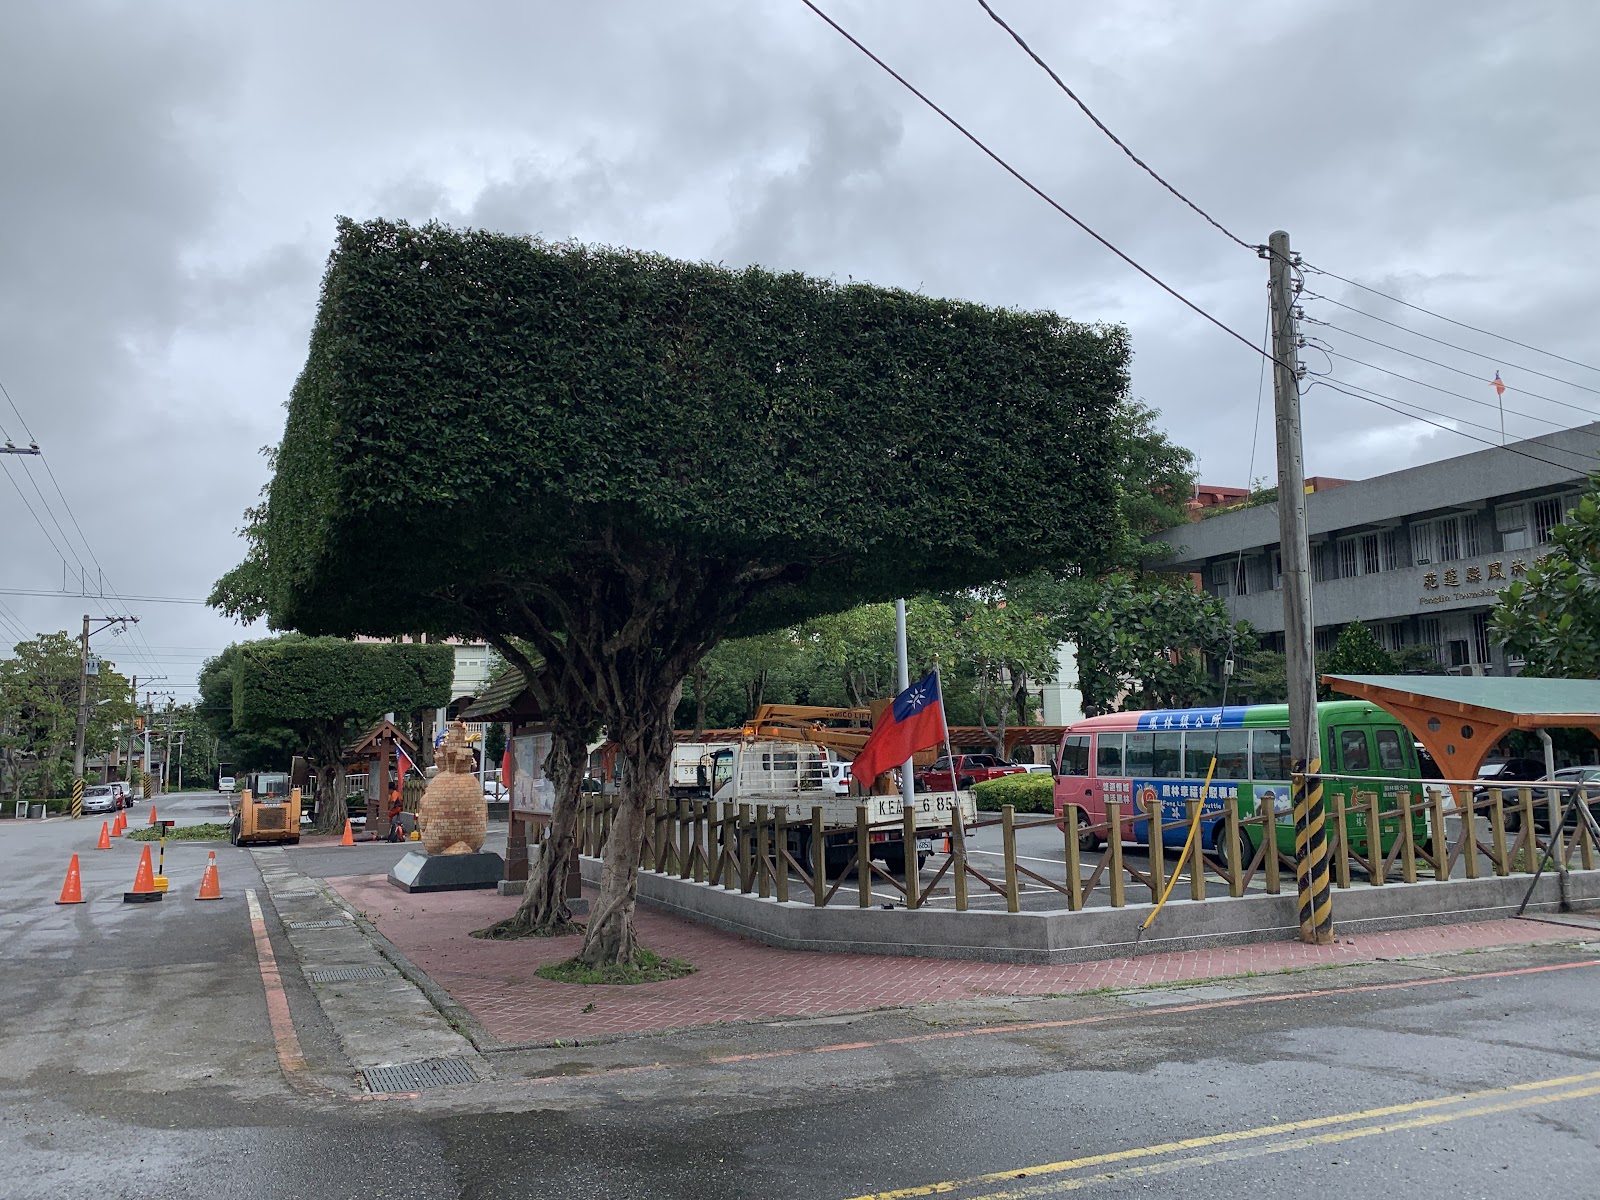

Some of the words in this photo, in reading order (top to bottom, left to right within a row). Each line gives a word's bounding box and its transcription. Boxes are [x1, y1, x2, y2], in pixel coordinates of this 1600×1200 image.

[1148, 713, 1222, 730] 鳳林鎮公所
[879, 800, 903, 815] KEA
